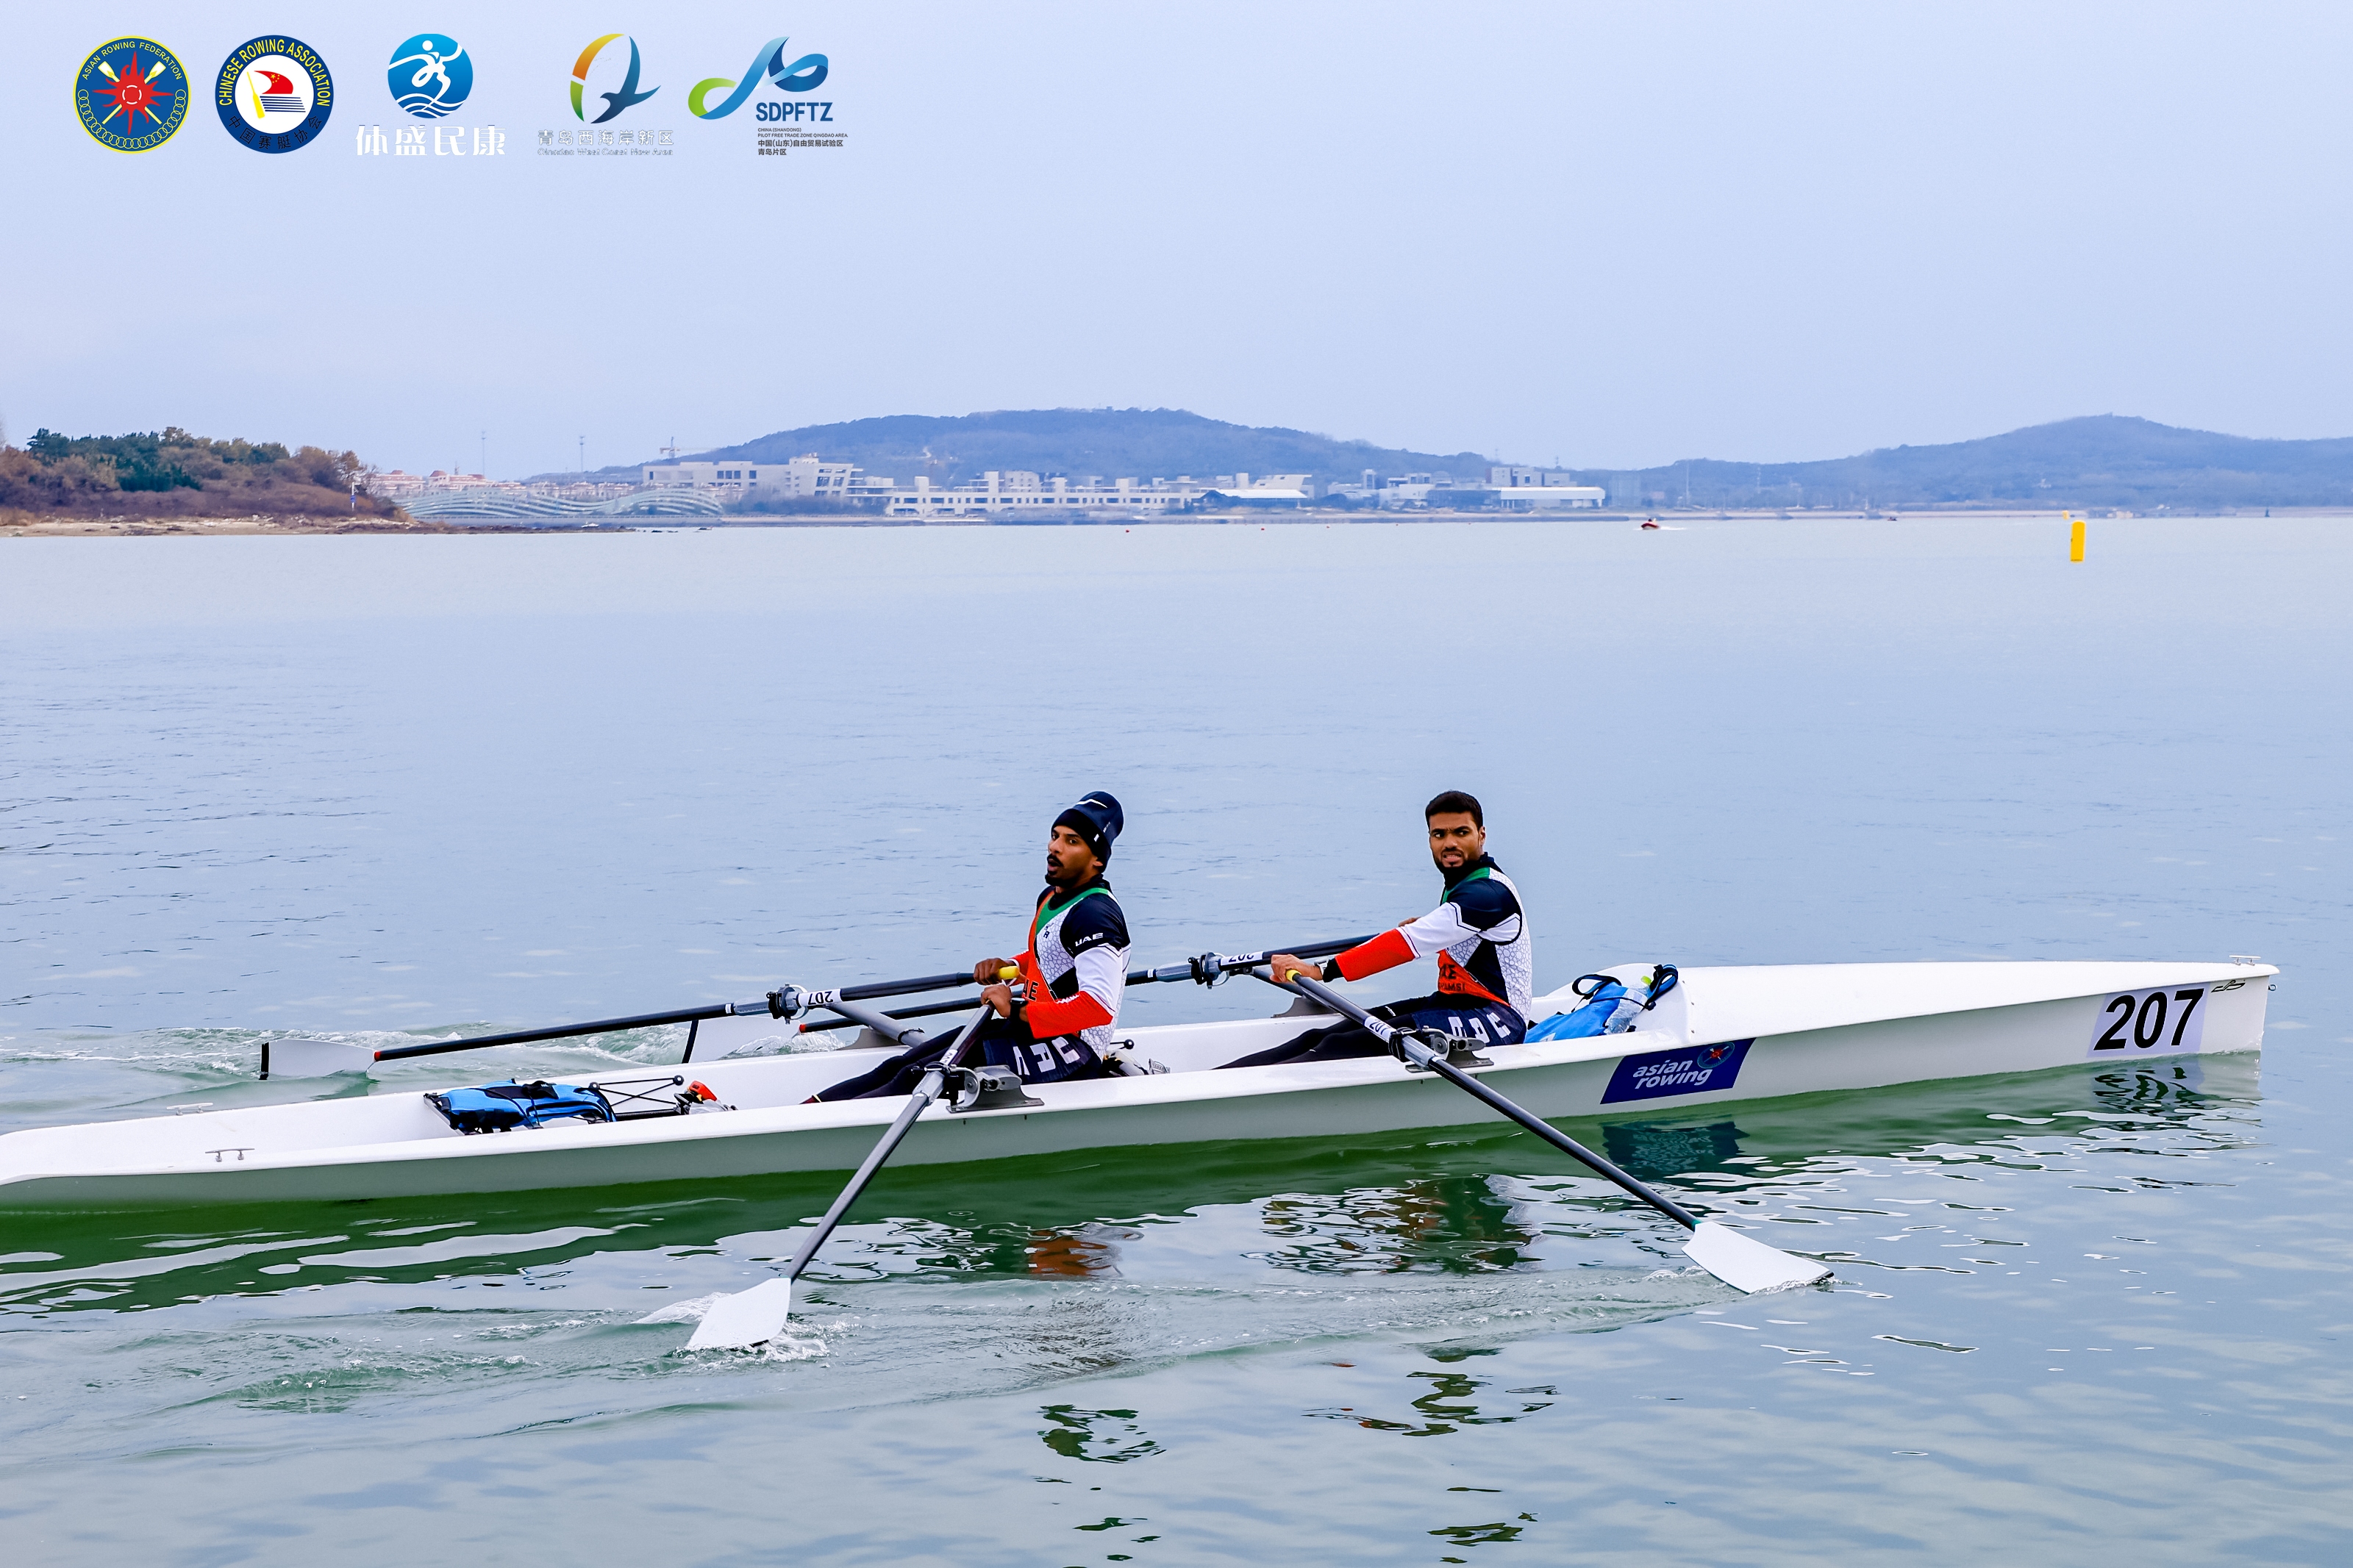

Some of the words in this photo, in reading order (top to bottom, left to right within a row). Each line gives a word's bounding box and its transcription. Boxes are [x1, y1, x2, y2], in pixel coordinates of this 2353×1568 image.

[1075, 933, 1104, 947] UAE
[807, 991, 833, 1005] 207
[2093, 988, 2204, 1051] 207
[1632, 1059, 1693, 1078] asian
[1635, 1069, 1713, 1089] rowing
